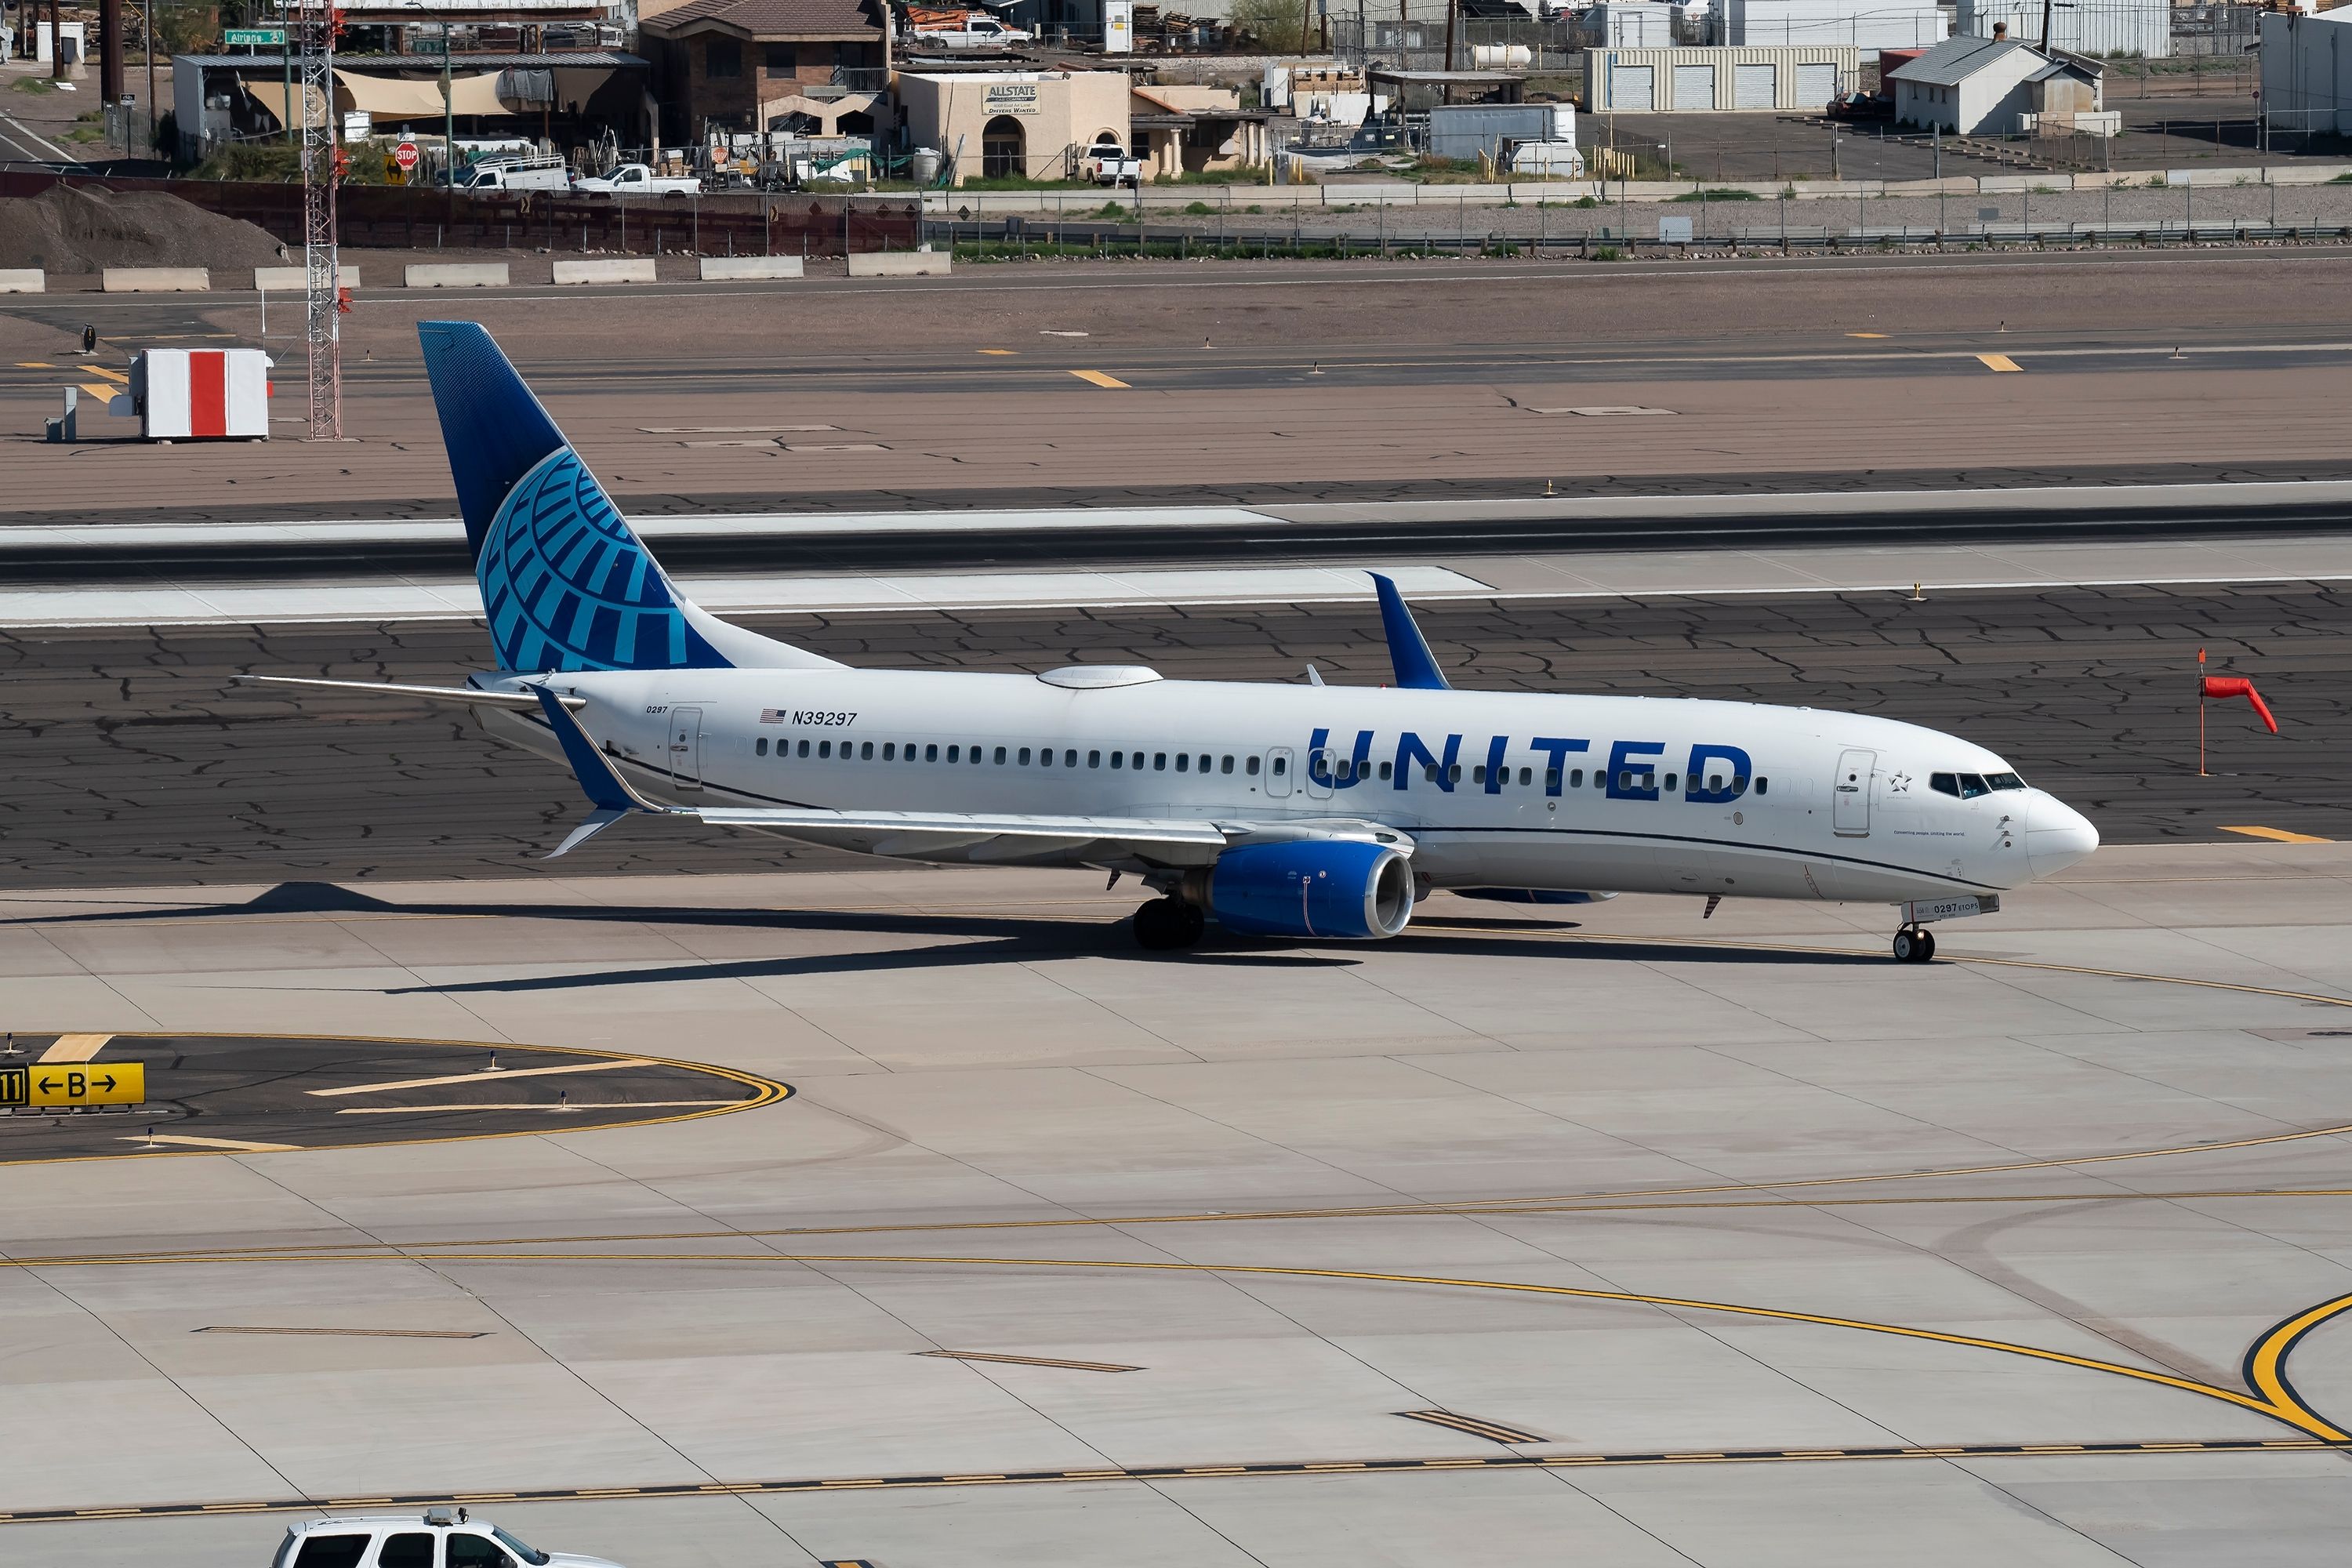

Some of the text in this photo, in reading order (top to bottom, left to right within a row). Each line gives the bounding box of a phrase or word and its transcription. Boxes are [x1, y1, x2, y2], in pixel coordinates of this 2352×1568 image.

[989, 85, 1036, 96] ALLSTATE
[397, 150, 417, 160] STOP
[792, 711, 858, 726] N39297
[1308, 728, 1751, 804] UNITED
[1934, 903, 1957, 913] 0297
[1958, 902, 1979, 911] ETOPS
[67, 1073, 86, 1098] B
